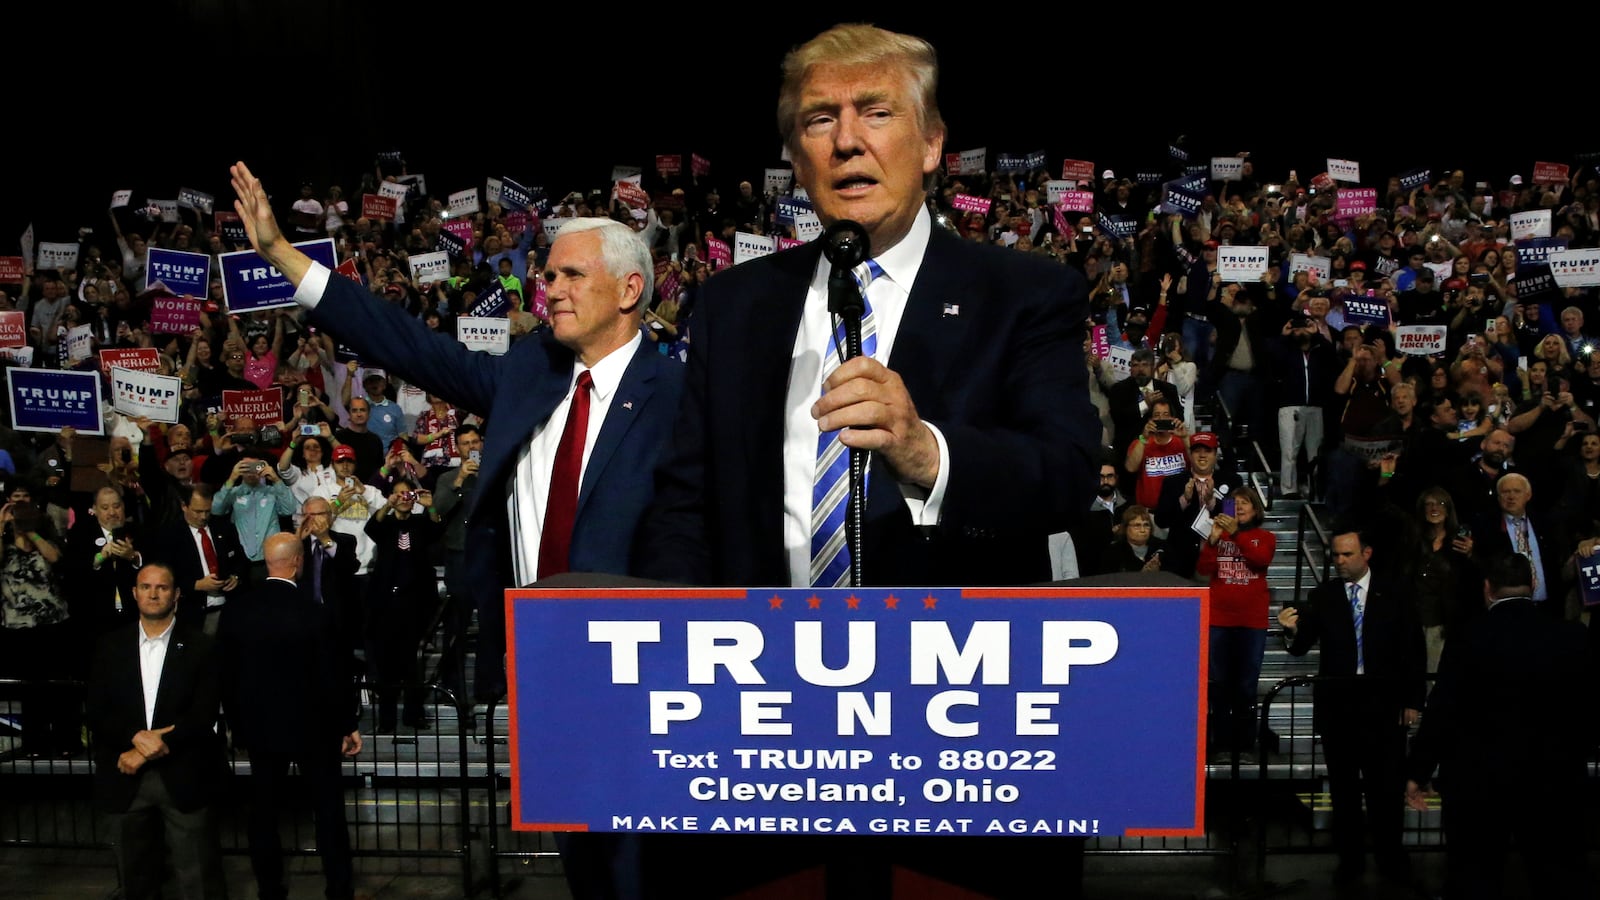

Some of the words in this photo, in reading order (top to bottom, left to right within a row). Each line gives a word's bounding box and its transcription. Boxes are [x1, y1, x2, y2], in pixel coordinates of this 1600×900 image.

[1399, 169, 1431, 183] TRUMP
[382, 187, 405, 195] TRUMP
[487, 184, 500, 192] TRU
[503, 185, 530, 202] TRUMP
[182, 192, 211, 205] TRUMP
[451, 194, 475, 205] TRUMP
[955, 193, 992, 205] WOMEN
[1168, 190, 1202, 206] TRUMP
[1337, 190, 1376, 199] WOMEN
[954, 202, 987, 213] TRUMP
[1339, 206, 1375, 216] TRUMP
[798, 221, 819, 229] TRU
[1114, 220, 1138, 228] TRUMP
[440, 228, 463, 251] TRUMP
[738, 241, 773, 252] TRUMP
[1518, 245, 1566, 256] TRUMP
[413, 259, 447, 270] TRUMP
[1551, 258, 1600, 268] TRUMP
[152, 262, 205, 276] TRUMP
[239, 265, 282, 282] TRU
[156, 271, 200, 281] PENCE
[1516, 274, 1551, 289] TRUMP
[154, 300, 201, 312] WOMEN
[470, 287, 503, 318] TRUMP
[1344, 300, 1387, 311] TRUMP
[167, 312, 185, 321] FOR
[1349, 306, 1384, 316] PENCE
[0, 323, 24, 333] RICA
[153, 321, 199, 332] TRUMP
[462, 327, 507, 335] TRUMP
[1400, 333, 1441, 343] TRUMP
[1426, 341, 1441, 349] '16
[103, 357, 160, 370] AMERICA
[17, 386, 92, 401] TRUMP
[115, 380, 175, 398] TRUMP
[25, 398, 86, 409] PENCE
[120, 391, 169, 406] PENCE
[226, 401, 281, 413] AMERICA
[255, 411, 279, 420] AGAIN
[588, 620, 1119, 687] TRUMP
[649, 690, 1060, 738] PENCE
[652, 749, 719, 769] Text
[733, 749, 874, 770] TRUMP
[888, 752, 923, 771] to
[938, 749, 1057, 771] 88022
[689, 777, 906, 806] Cleveland,
[922, 778, 1020, 803] Ohio
[612, 815, 699, 831] MAKE
[710, 816, 857, 833] AMERICA
[868, 818, 973, 833] GREAT
[985, 819, 1100, 834] AGAIN!
